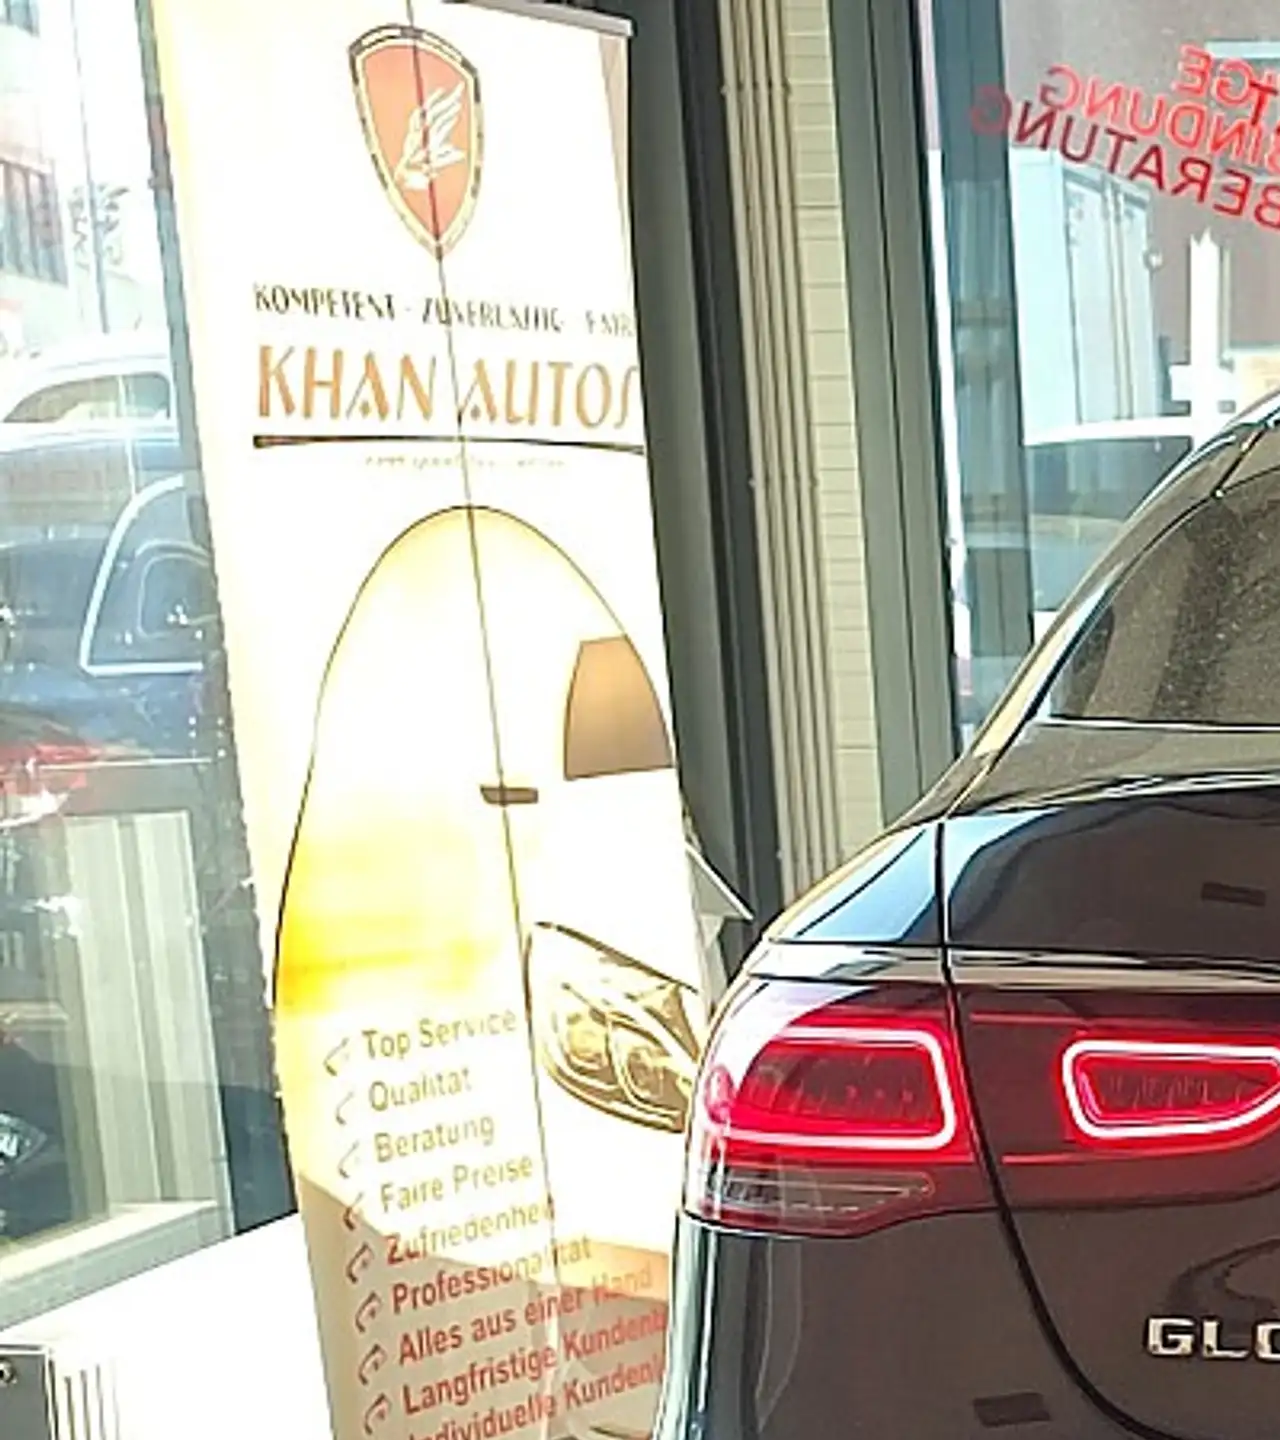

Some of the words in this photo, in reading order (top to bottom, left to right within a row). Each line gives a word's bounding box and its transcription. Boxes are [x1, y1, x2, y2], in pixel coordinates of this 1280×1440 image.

[258, 344, 437, 424] KHAN
[458, 356, 639, 430] AUTOS
[362, 1029, 411, 1060] Top
[399, 1330, 463, 1364] Alles
[473, 1309, 517, 1341] aus
[402, 1341, 557, 1416] Langfristige
